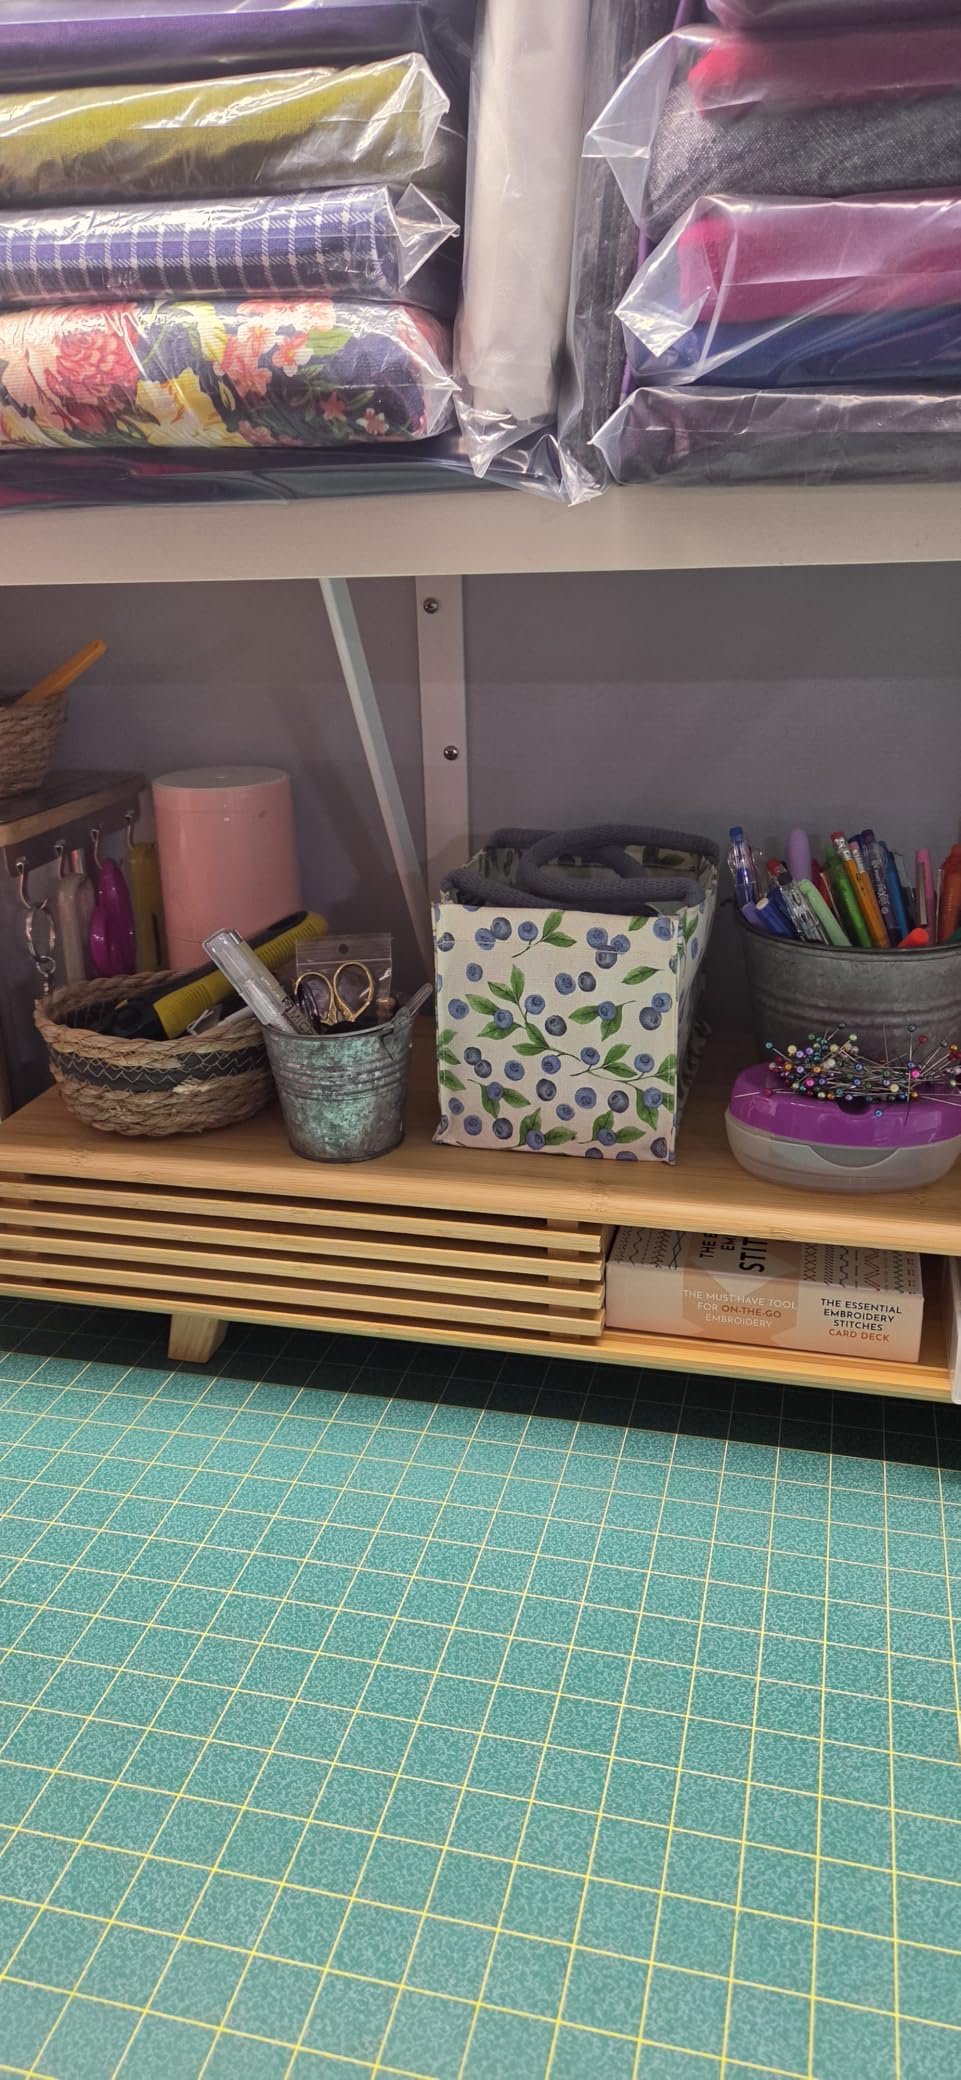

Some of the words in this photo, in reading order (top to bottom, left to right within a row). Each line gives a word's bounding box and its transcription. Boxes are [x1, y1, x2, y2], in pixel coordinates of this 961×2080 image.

[699, 1240, 717, 1258] THE
[739, 1237, 768, 1273] STIT
[684, 1289, 704, 1299] THE
[769, 1299, 797, 1310] TOOL
[821, 1298, 842, 1308] THE
[845, 1300, 903, 1315] ESSENTIAL
[697, 1301, 718, 1311] FOR
[721, 1304, 782, 1319] ON-THE-GO
[823, 1308, 895, 1323] EMBROIDERY
[705, 1313, 773, 1328] EMBROIDERY
[833, 1319, 884, 1332] STITCHES
[828, 1328, 858, 1339] CARD
[860, 1331, 890, 1342] DECK
